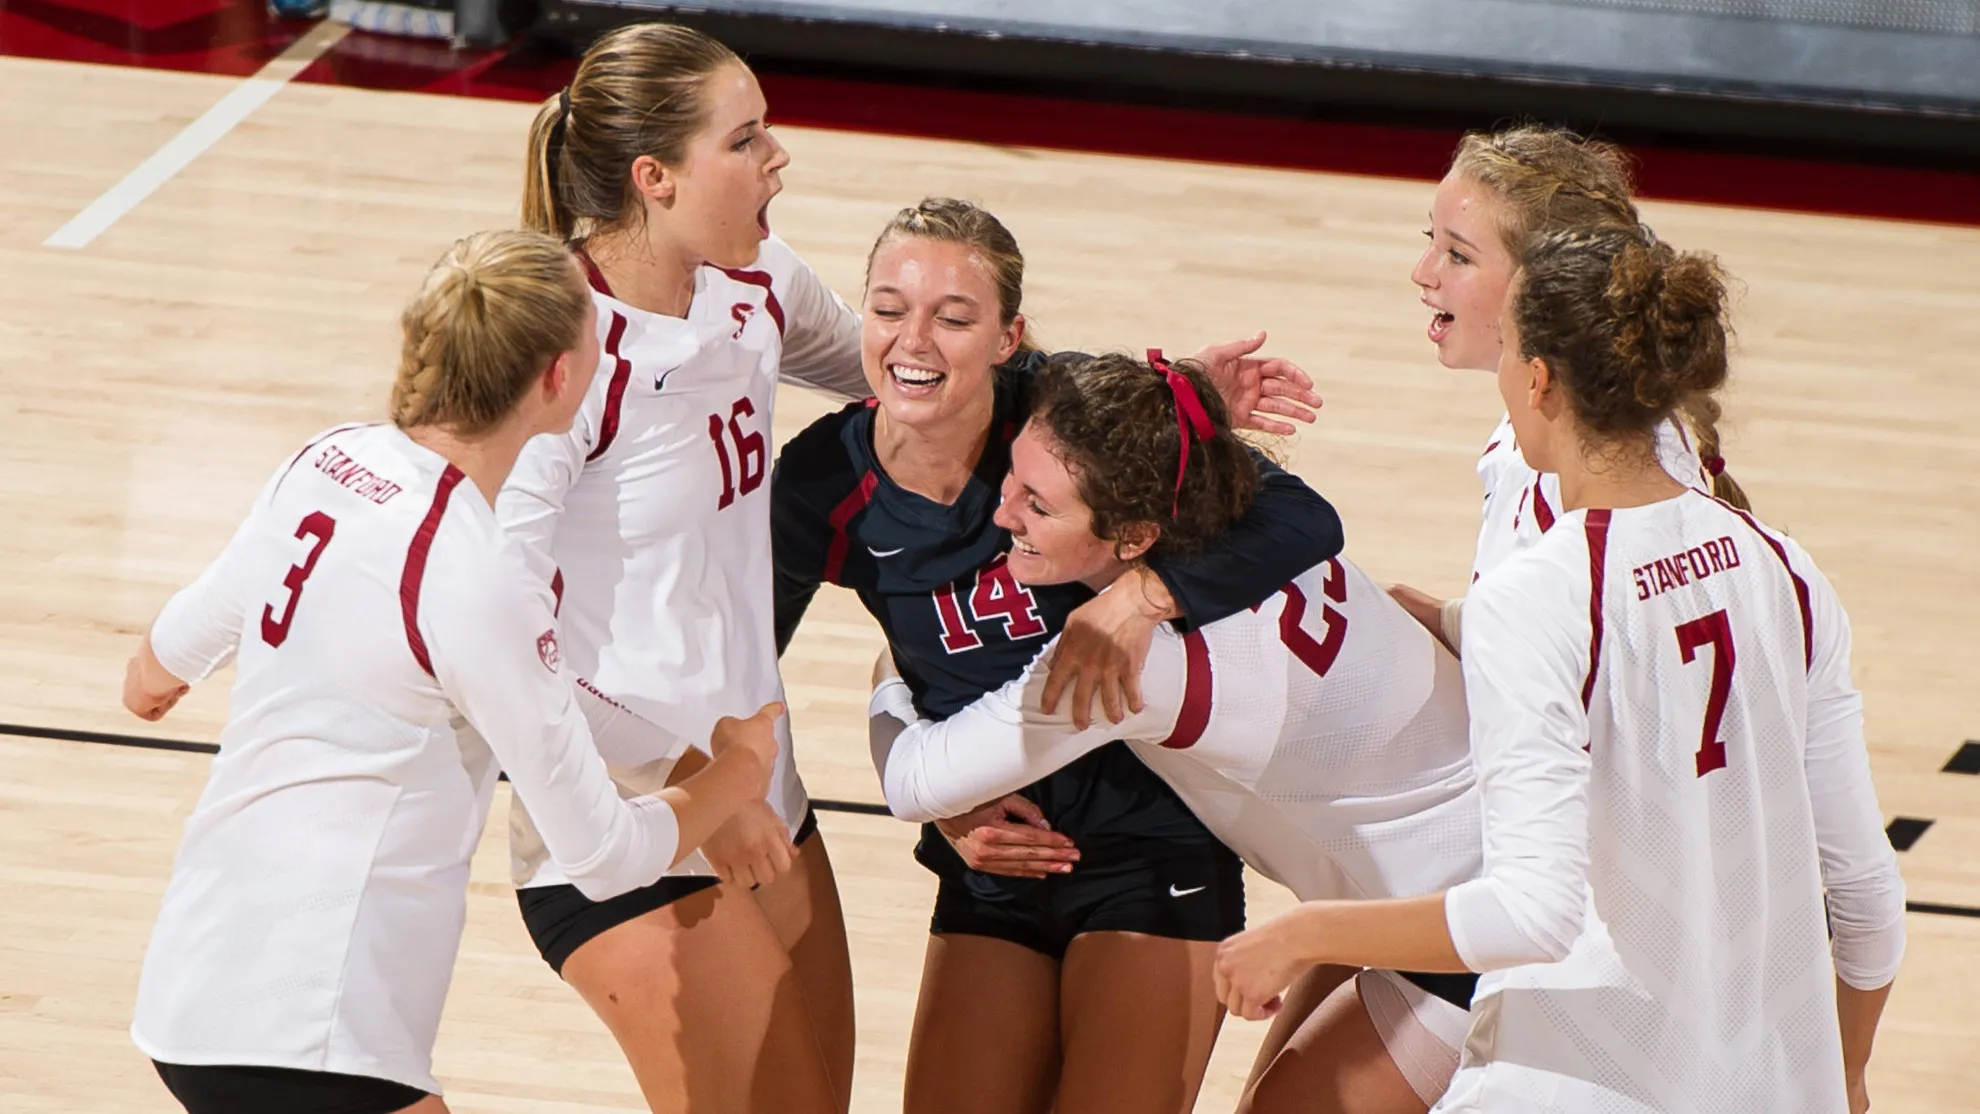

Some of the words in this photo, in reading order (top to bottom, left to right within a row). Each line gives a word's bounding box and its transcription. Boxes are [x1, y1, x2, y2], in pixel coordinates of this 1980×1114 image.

[314, 444, 404, 506] STANFORD
[708, 396, 766, 511] 16
[260, 510, 336, 649] 3
[932, 551, 1048, 655] 14
[1633, 536, 1741, 602] STANFORD
[1674, 608, 1737, 779] 7
